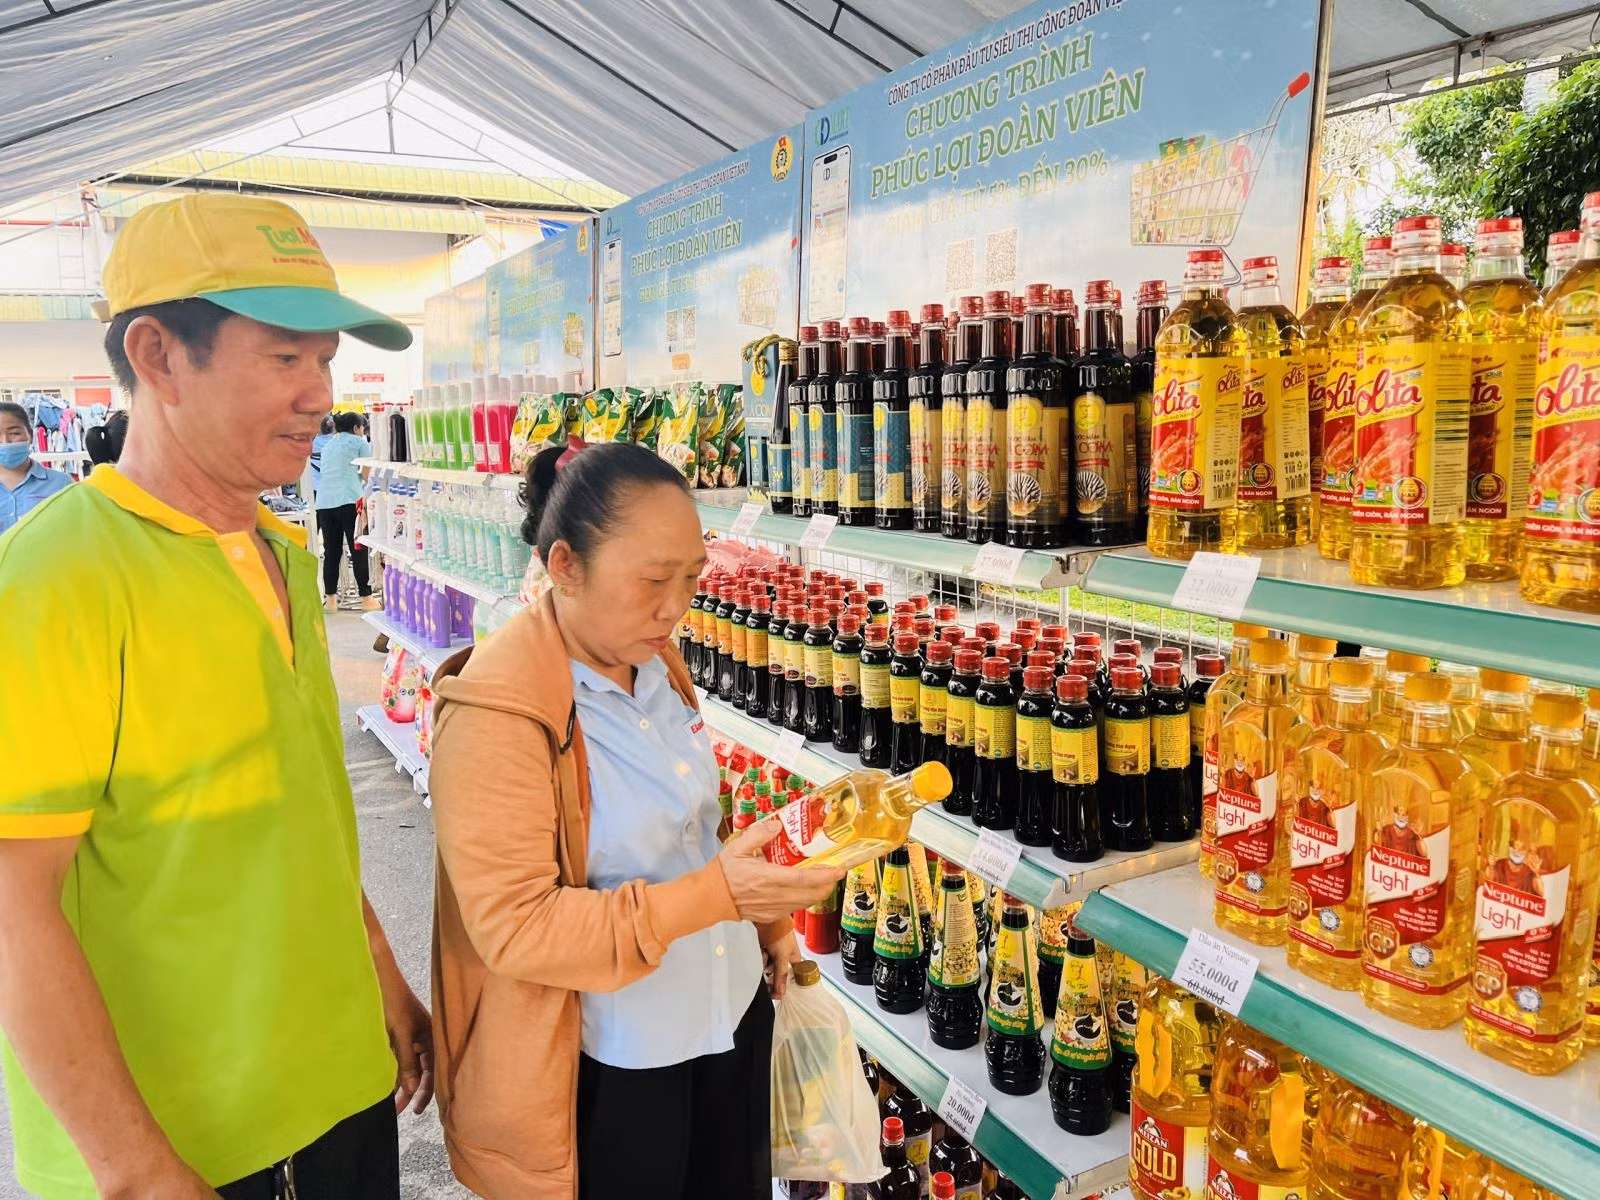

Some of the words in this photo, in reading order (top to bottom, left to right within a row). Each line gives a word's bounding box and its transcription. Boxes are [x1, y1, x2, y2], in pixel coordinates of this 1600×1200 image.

[888, 81, 910, 106] CÔNG
[910, 76, 922, 97] TY
[933, 51, 958, 87] PHẦN
[958, 42, 979, 75] ĐẦU
[978, 46, 995, 66] TƯ
[993, 30, 1016, 60] SIÊU
[1016, 29, 1035, 50] THỊ
[1036, 10, 1066, 38] CÔNG
[906, 75, 999, 138] CHƯƠNG
[1005, 34, 1093, 100] TRÌNH
[871, 147, 929, 198] PHÚC
[933, 134, 973, 183] LỢI
[977, 103, 1058, 164] ĐOÀN
[1065, 69, 1145, 133] VIÊN
[1018, 152, 1059, 200] ĐẾN
[1065, 152, 1108, 187] 30%
[646, 204, 687, 240] CHƯƠNG
[689, 193, 722, 225] TRÌNH
[631, 246, 657, 276] PHÚC
[678, 231, 710, 265] ĐOÀN
[713, 217, 742, 252] VIÊN
[1205, 766, 1218, 785] Lig
[1219, 789, 1259, 809] Neptune
[787, 803, 799, 835] Light
[801, 800, 809, 844] Neptune
[1219, 804, 1245, 826] Light
[1294, 818, 1336, 843] Neptune
[1372, 848, 1428, 872] Neptune
[1372, 864, 1409, 892] Light
[1484, 882, 1544, 913] Neptune
[1481, 900, 1522, 931] Light
[1223, 944, 1250, 965] Neptune
[1188, 958, 1239, 992] 55.000đ
[1187, 978, 1226, 1006] 60.000đ
[947, 1096, 975, 1124] 20.000đ
[1139, 1127, 1168, 1148] MEIZAN
[1134, 1131, 1177, 1180] GOLD
